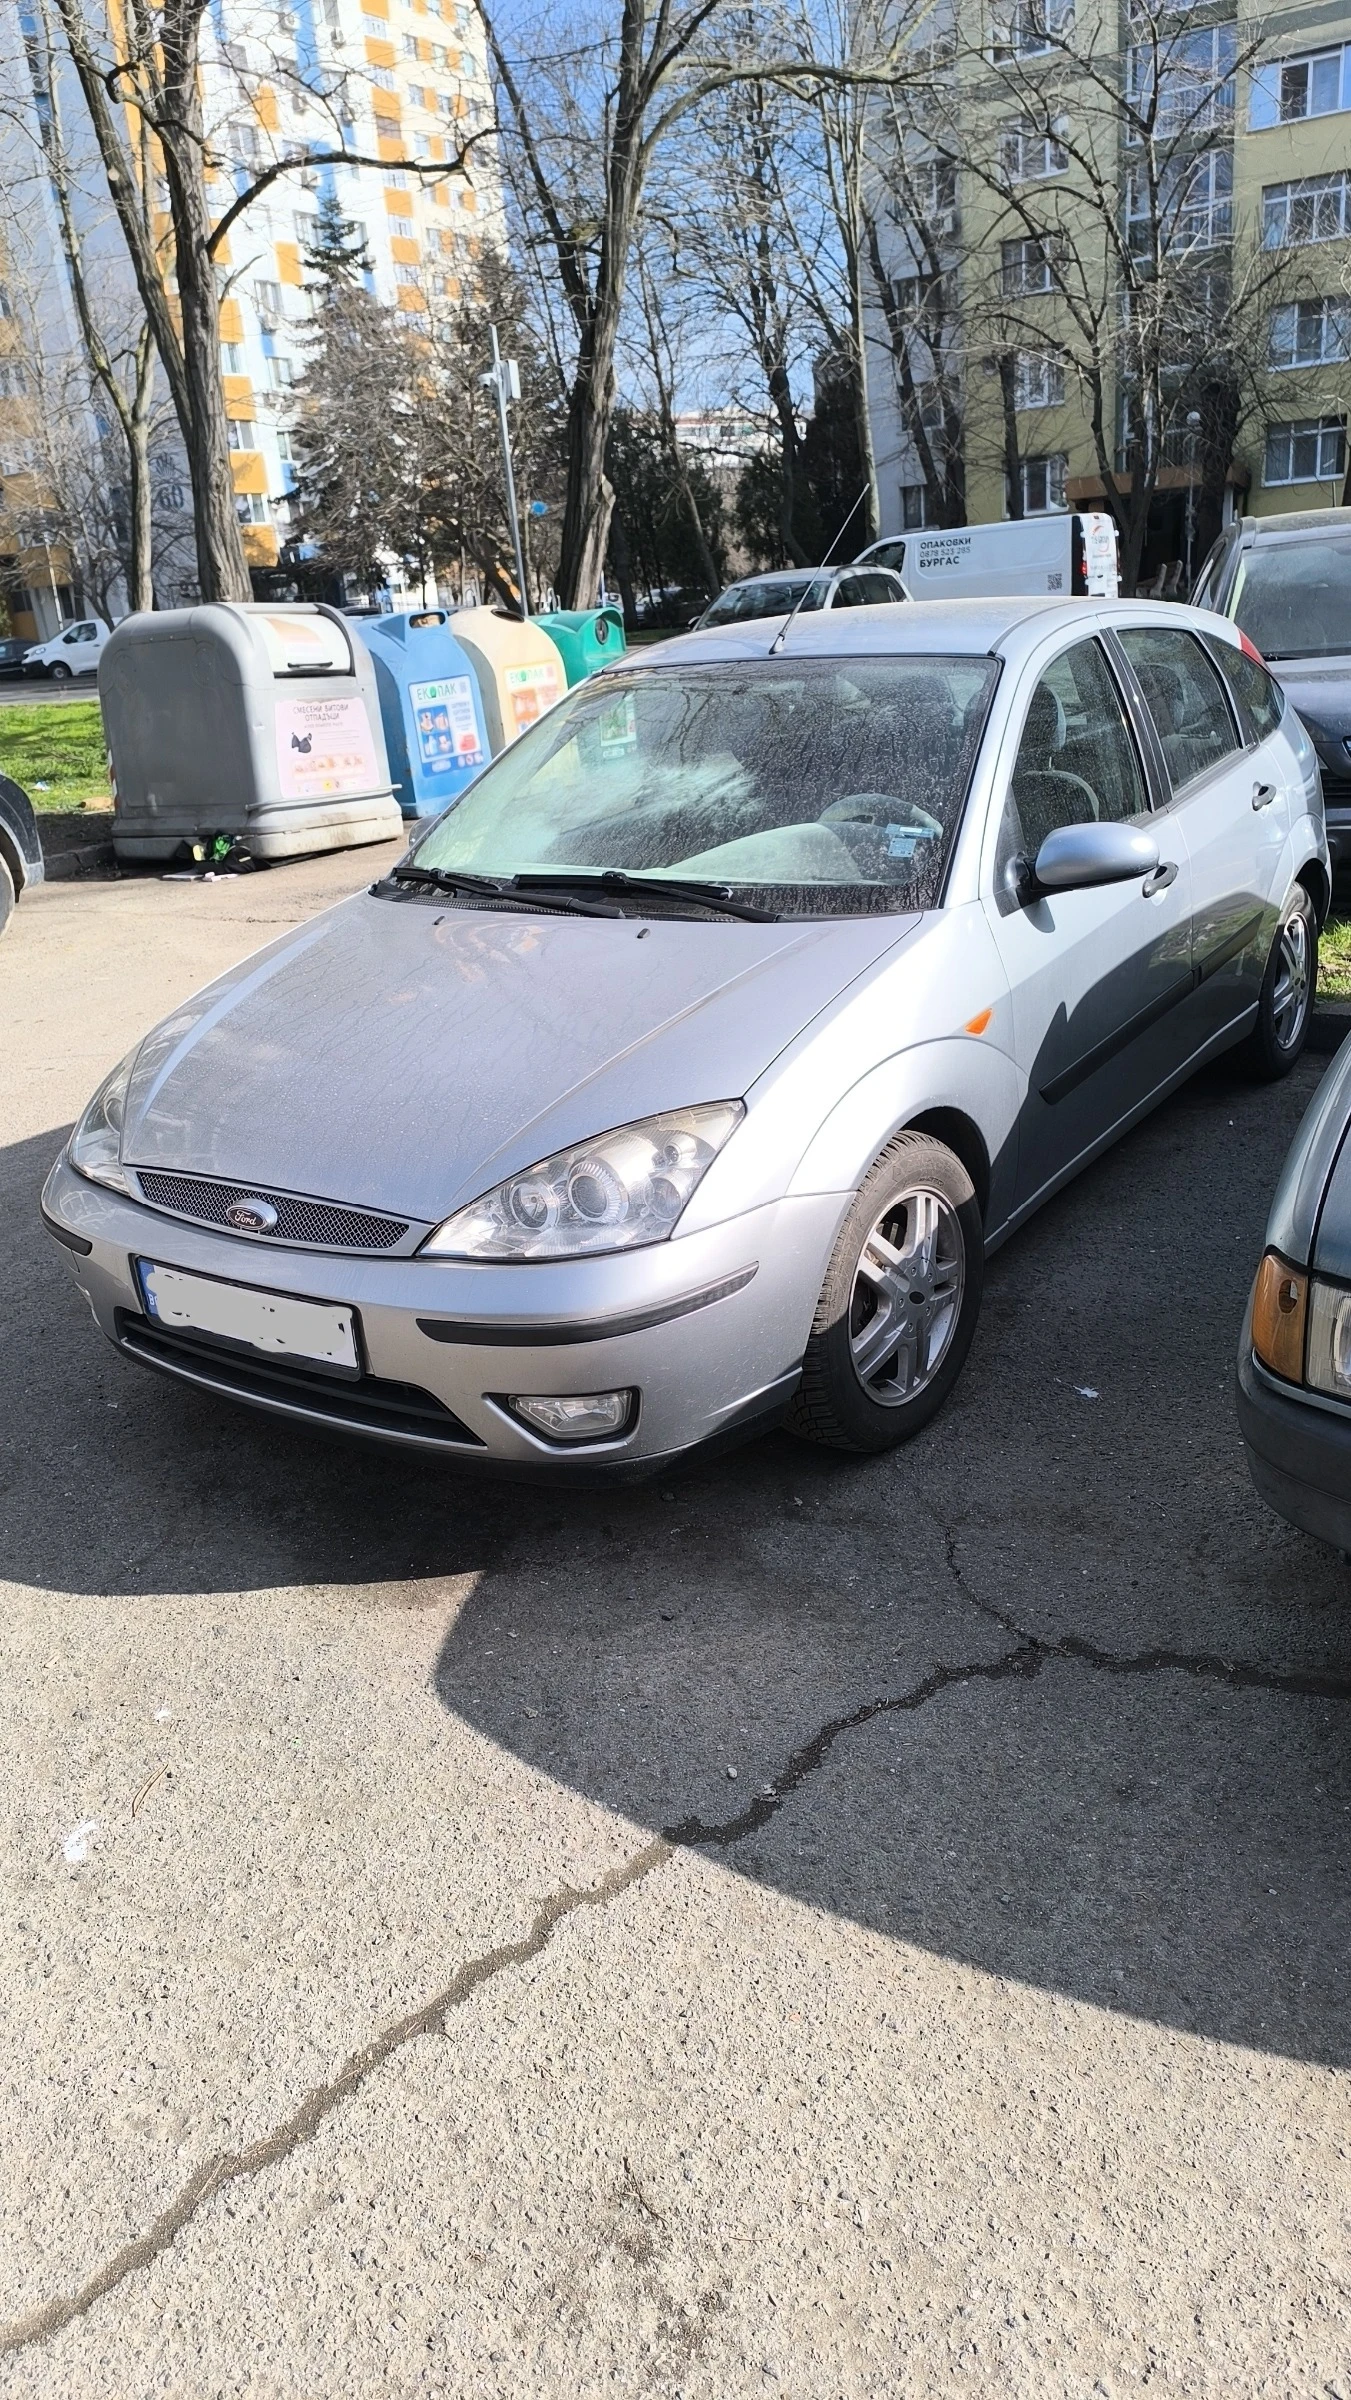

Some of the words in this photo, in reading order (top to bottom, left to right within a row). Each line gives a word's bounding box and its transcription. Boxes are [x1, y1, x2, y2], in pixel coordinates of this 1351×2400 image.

[160, 485, 184, 509] 60
[920, 537, 971, 549] ОПАКОВКИ
[920, 549, 939, 558] 0878
[920, 556, 960, 568] БУРГАС
[416, 683, 457, 700] ЕКОПАК
[304, 713, 340, 722] ОТПАДЪЦИ
[234, 1210, 257, 1225] Ford
